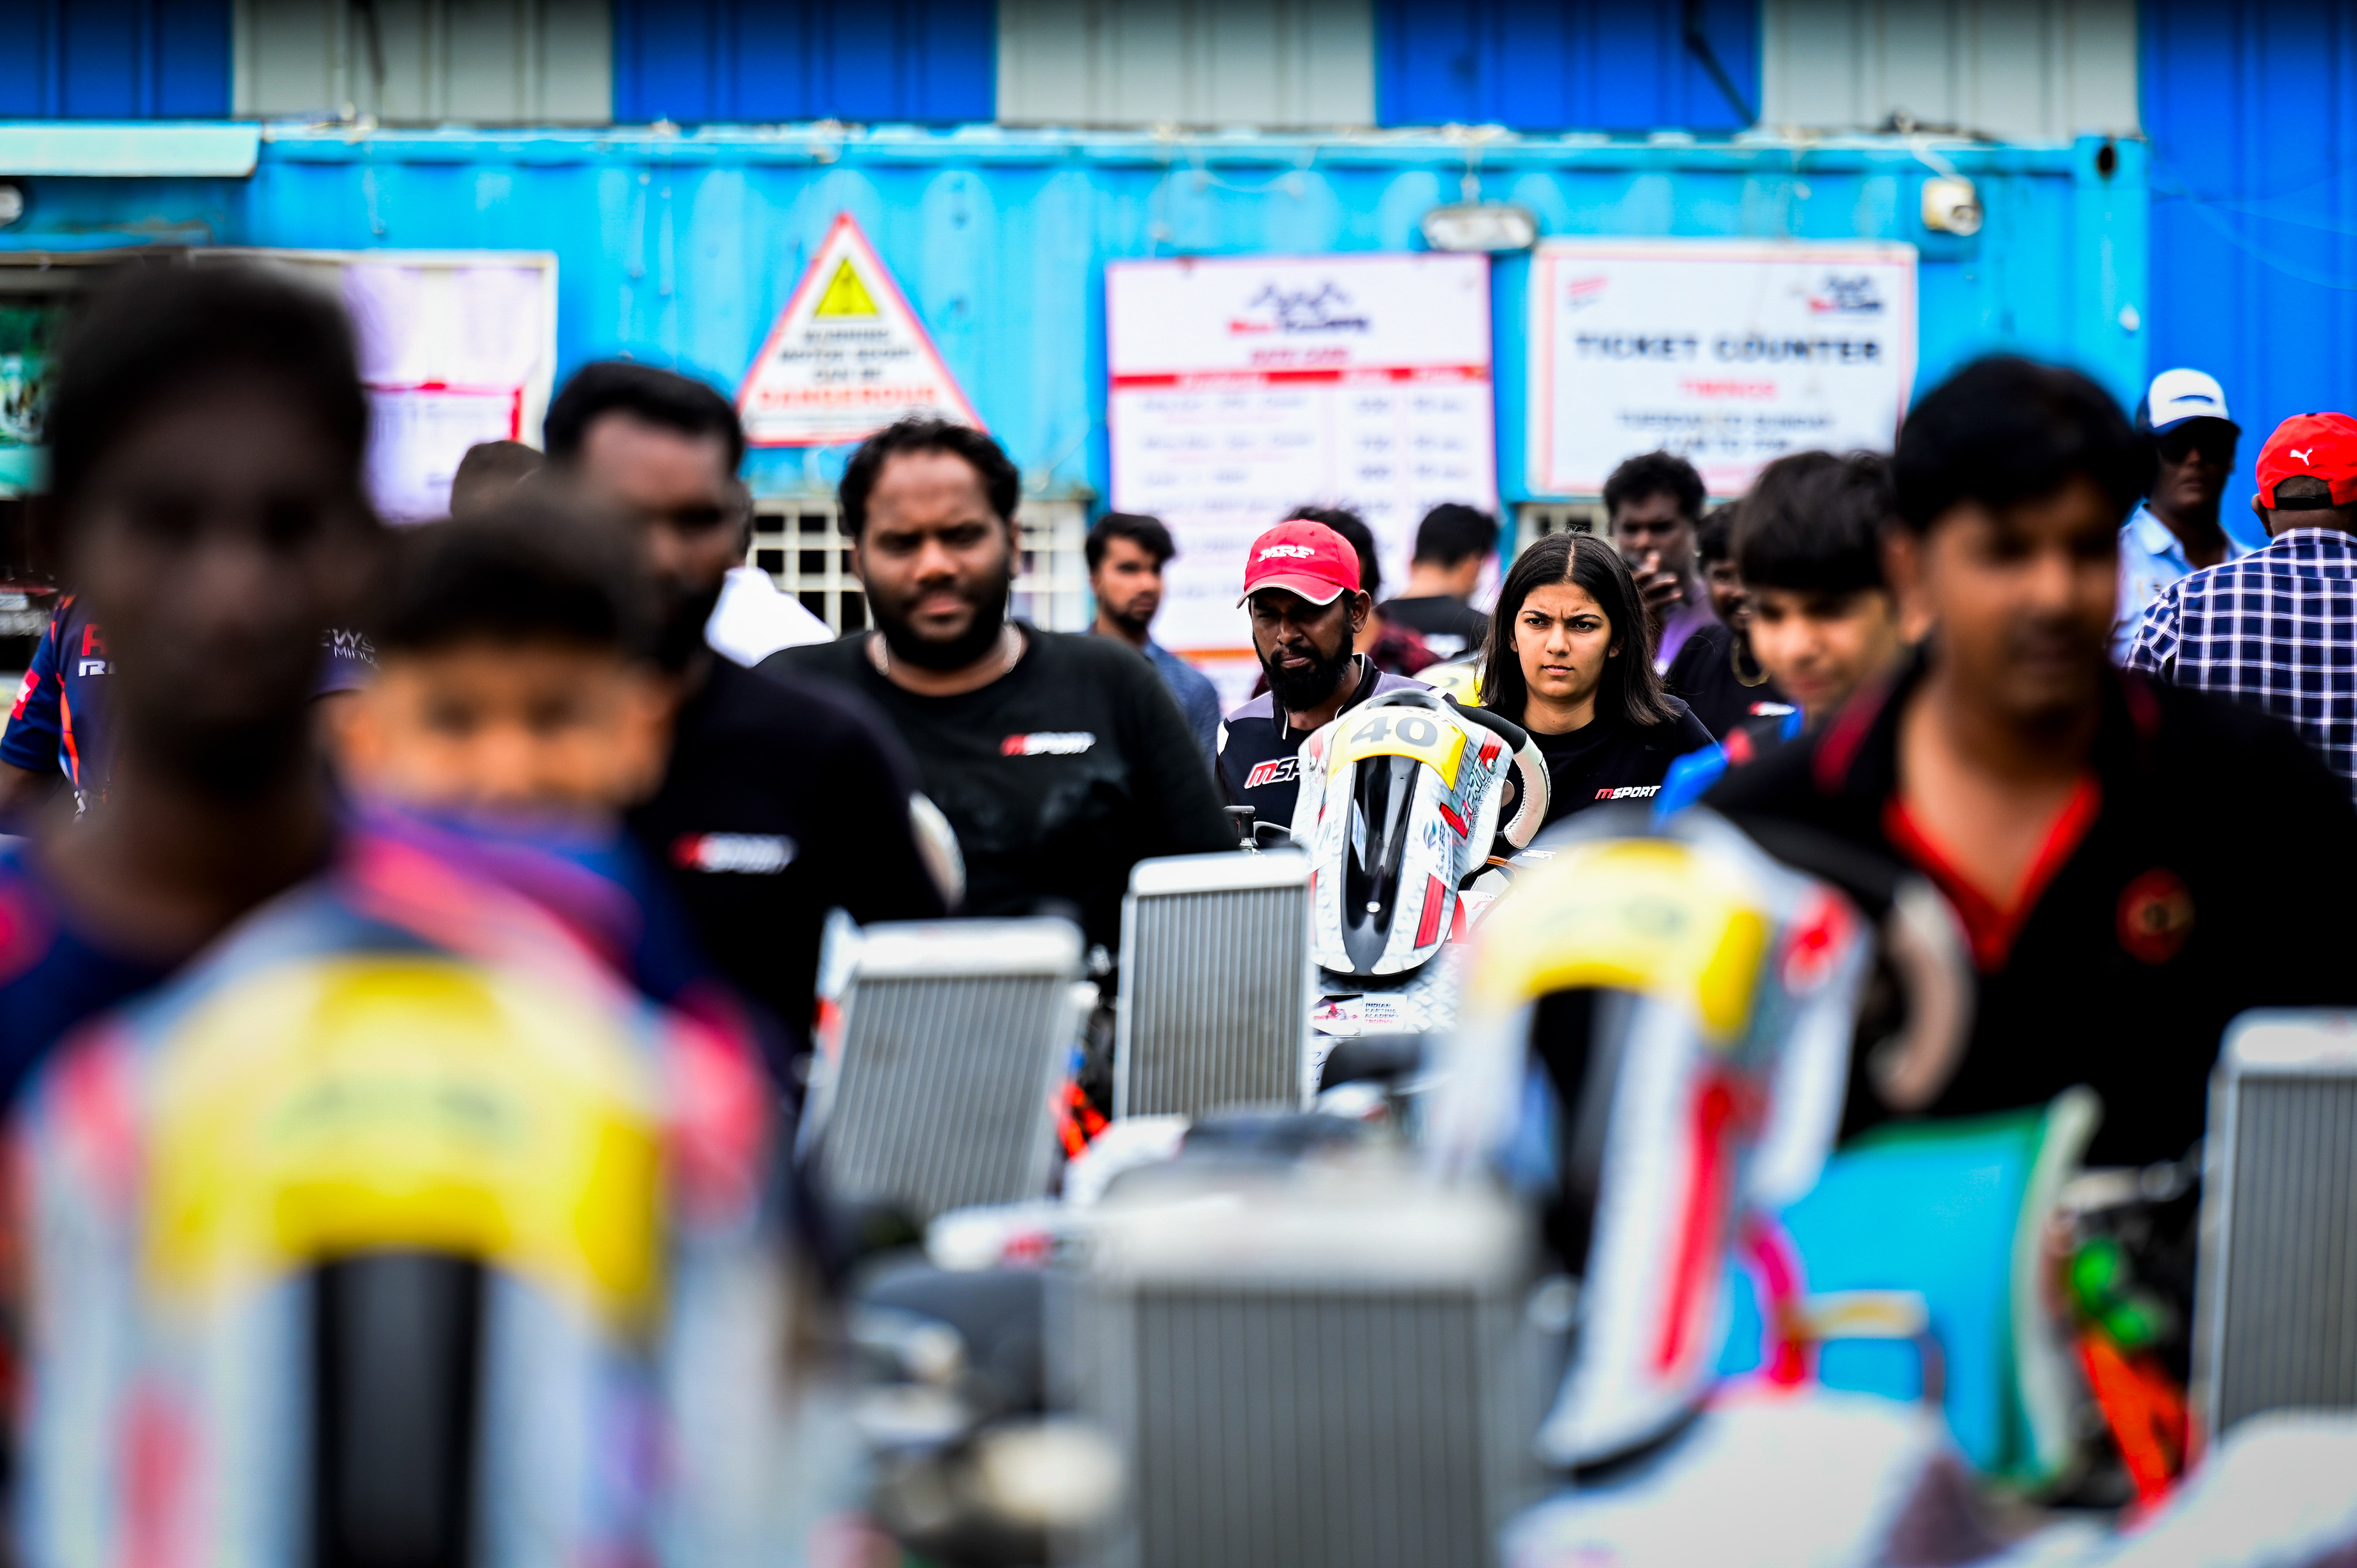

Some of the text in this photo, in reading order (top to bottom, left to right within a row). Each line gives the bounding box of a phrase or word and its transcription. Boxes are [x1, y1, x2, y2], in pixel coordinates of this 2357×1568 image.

[1576, 334, 1882, 365] TICKET COUNTER
[1258, 545, 1315, 562] MRF
[1350, 716, 1438, 747] 40
[1244, 756, 1299, 789] MSP
[1595, 785, 1662, 800] MSPORT
